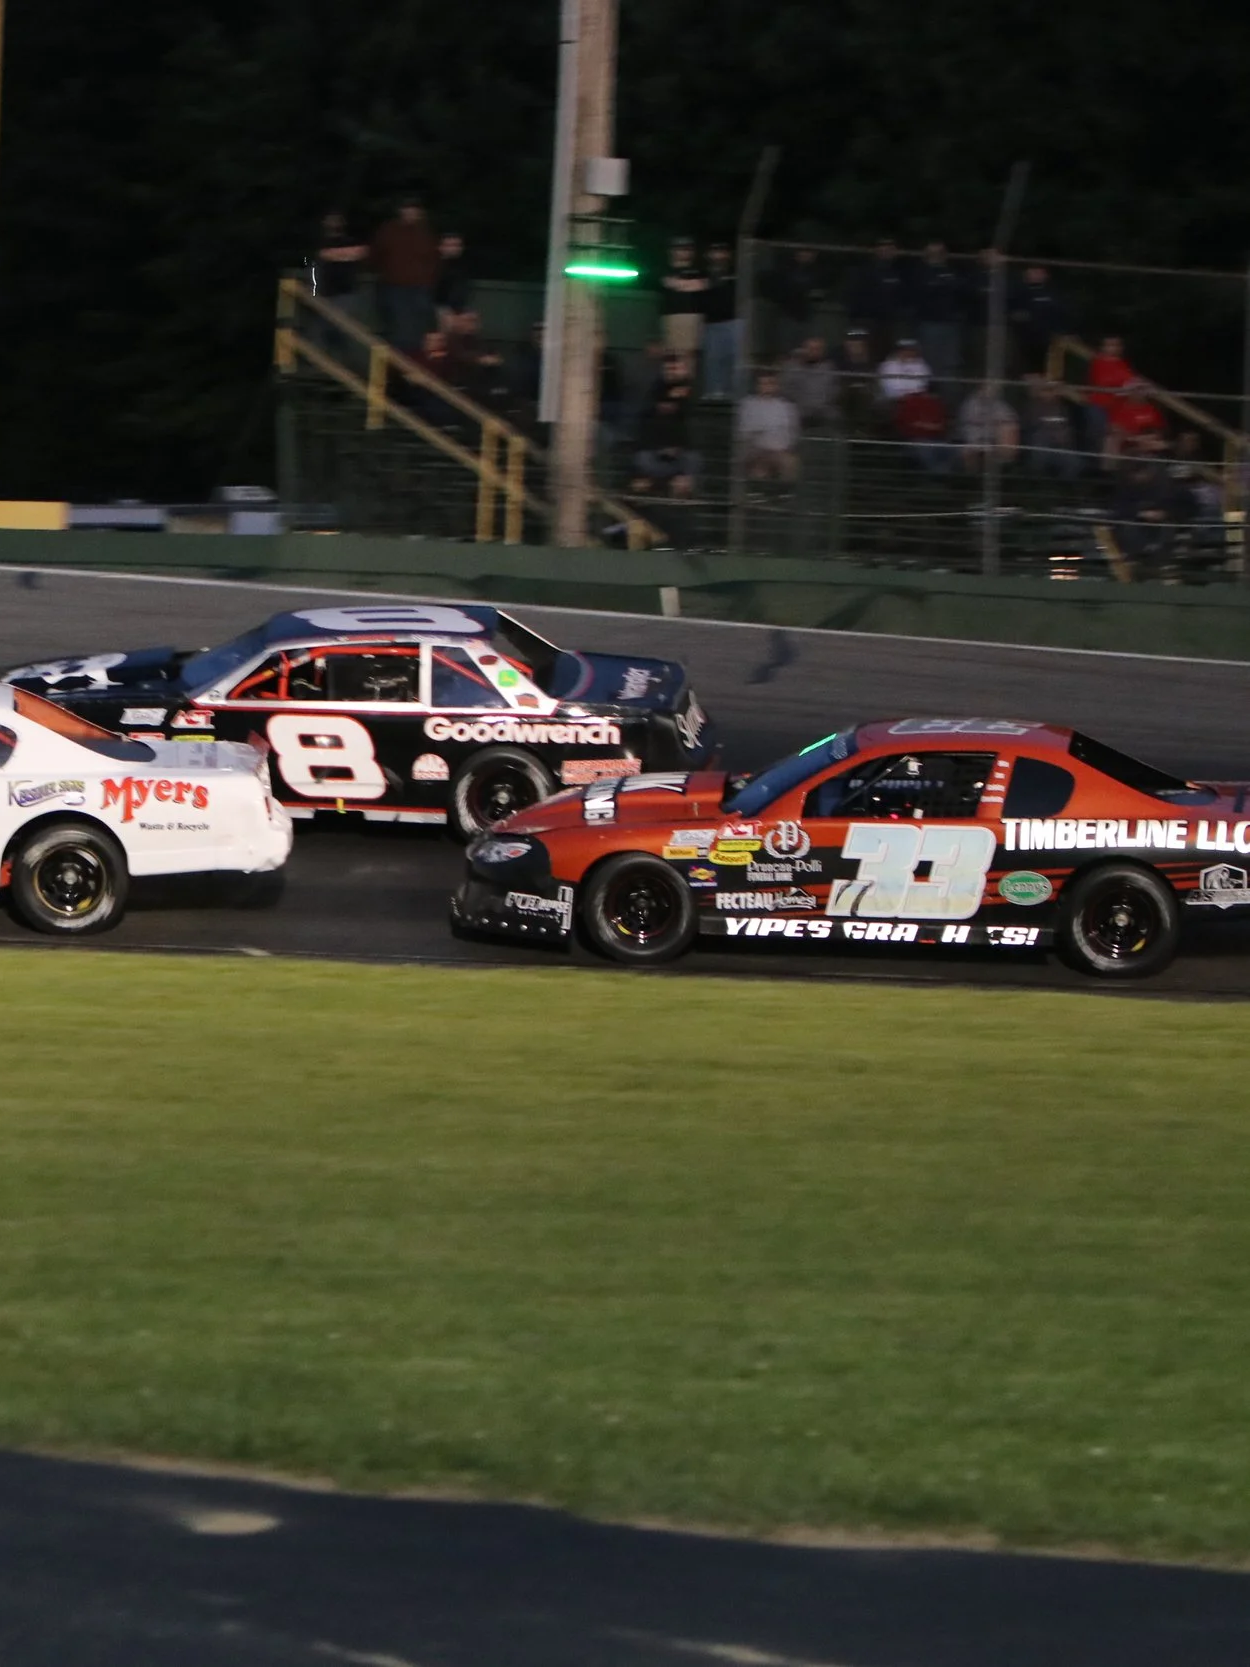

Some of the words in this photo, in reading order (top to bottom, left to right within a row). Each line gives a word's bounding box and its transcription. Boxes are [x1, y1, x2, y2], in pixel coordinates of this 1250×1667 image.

[423, 716, 621, 745] Goodwrench
[266, 713, 387, 799] 8
[100, 776, 209, 823] Myers
[176, 822, 210, 832] Recycle
[1000, 818, 1188, 851] TIMBERLINE
[1196, 820, 1250, 854] LLC
[825, 823, 997, 919] 33
[715, 891, 775, 911] FECTEAU
[725, 917, 833, 938] YIPES
